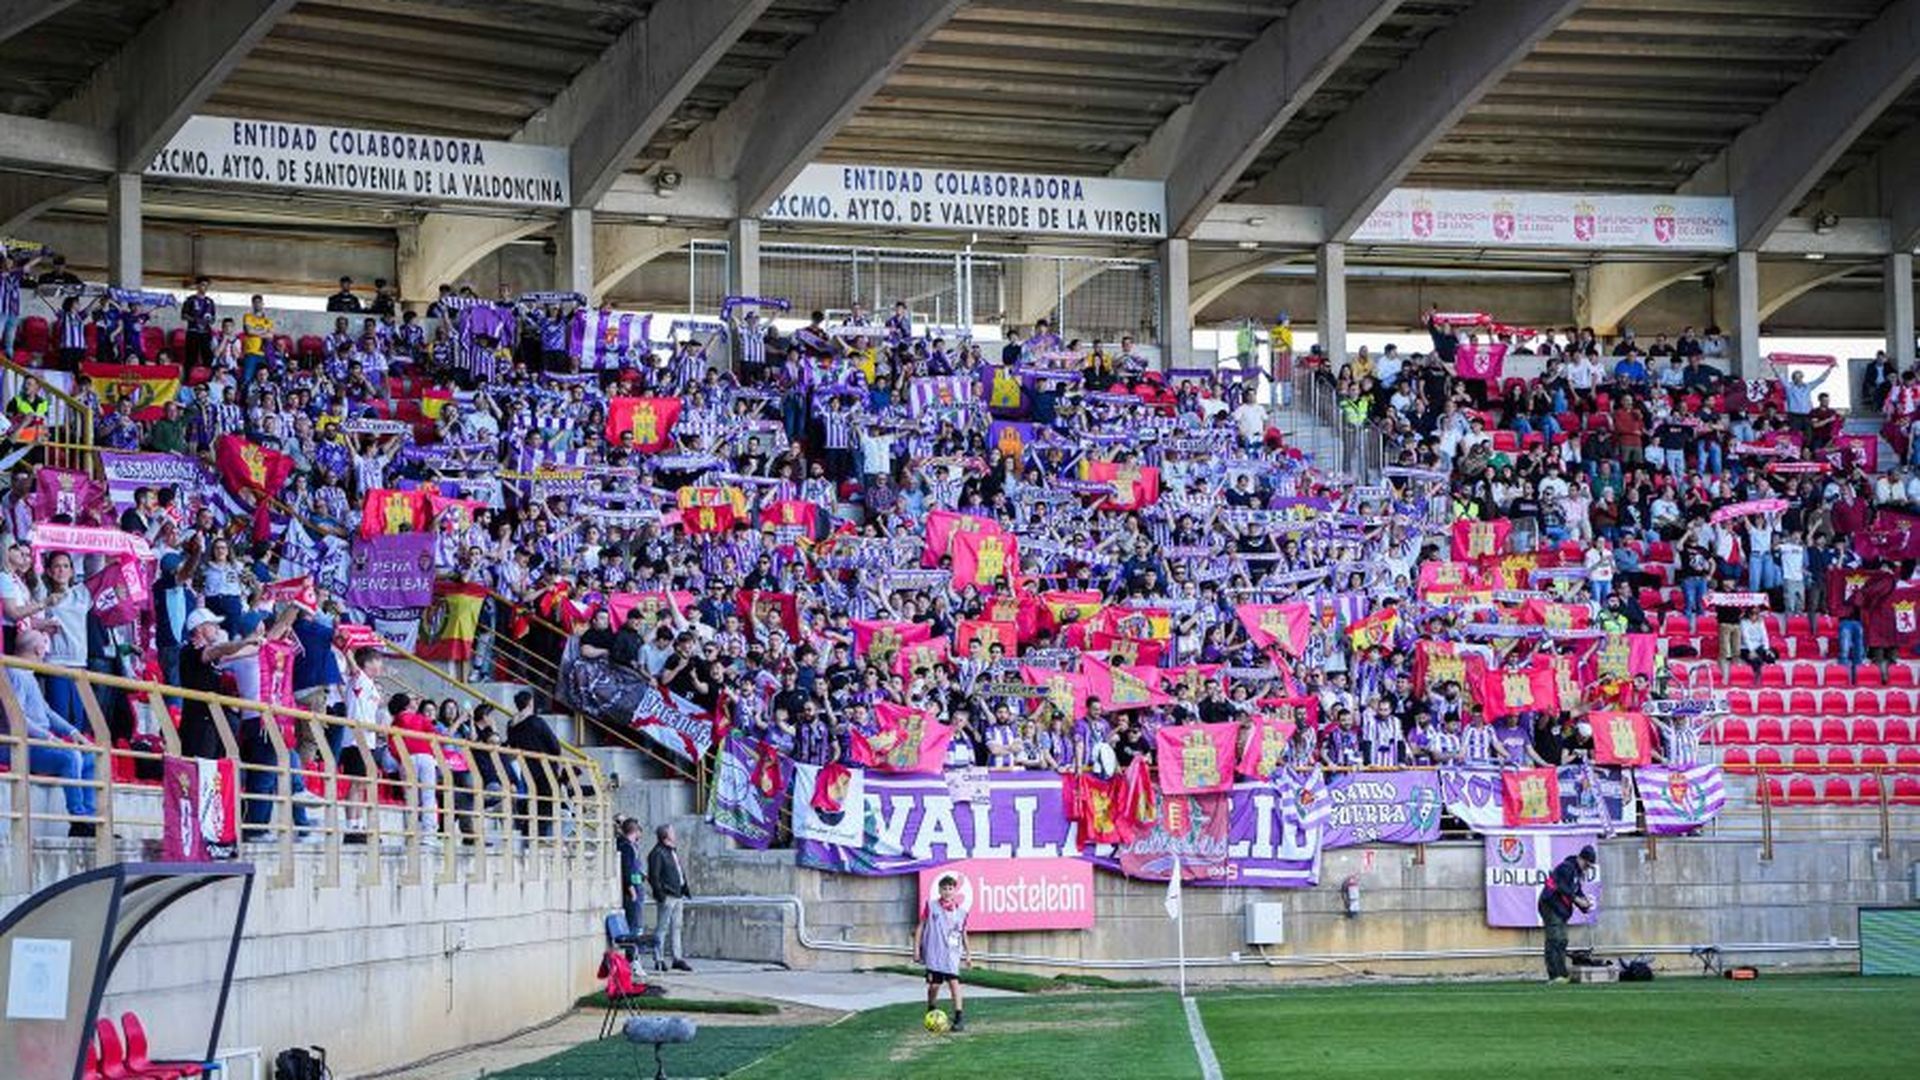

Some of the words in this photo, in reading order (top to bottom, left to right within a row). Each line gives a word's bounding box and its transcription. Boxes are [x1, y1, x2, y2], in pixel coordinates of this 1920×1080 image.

[233, 121, 317, 150] ENTIDAD
[329, 130, 485, 166] COLABORADORA
[222, 155, 270, 182] AYTO.
[278, 160, 297, 182] DE
[304, 162, 406, 191] SANTOVENIA
[414, 170, 431, 193] DE
[439, 172, 458, 195] LA
[464, 175, 563, 203] VALDONCINA
[843, 168, 923, 193] ENTIDAD
[935, 173, 1085, 200] COLABORADORA
[847, 197, 902, 222] AYTO.
[910, 200, 932, 223] DE
[940, 201, 1030, 228] VALVERDE
[1038, 205, 1059, 228] DE
[1067, 207, 1088, 230] LA
[1094, 209, 1162, 234] VIRGEN
[978, 876, 1086, 913] hosteleón
